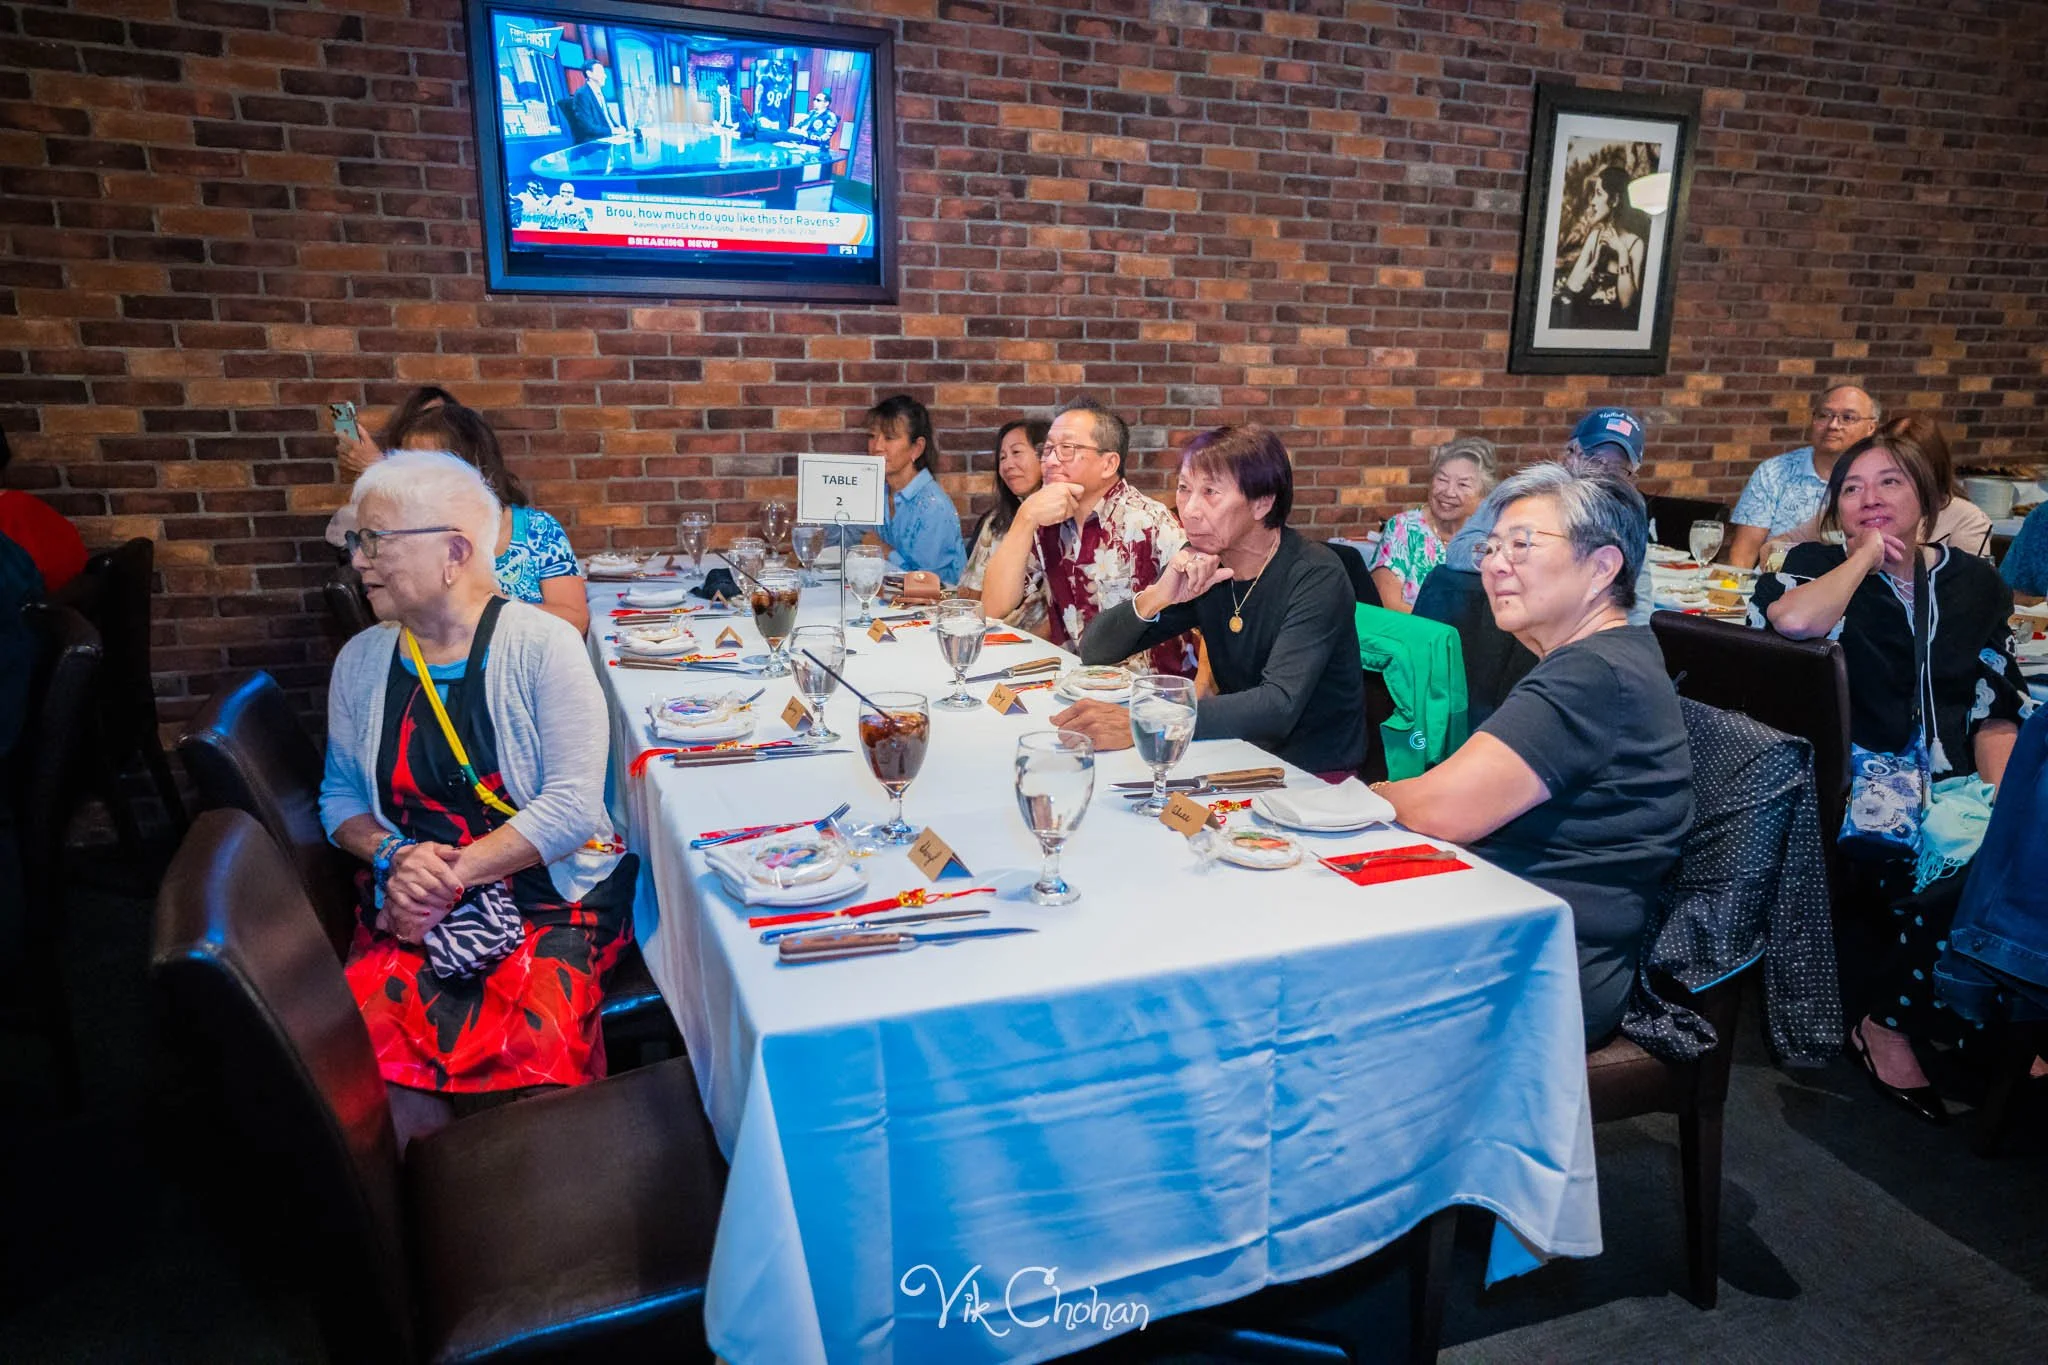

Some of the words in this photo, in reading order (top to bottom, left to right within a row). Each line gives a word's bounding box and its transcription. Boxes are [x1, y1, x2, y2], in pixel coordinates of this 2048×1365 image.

[525, 32, 552, 48] FIRST
[766, 91, 782, 108] 98
[638, 207, 662, 219] how
[664, 210, 696, 220] much
[698, 211, 712, 221] do
[714, 214, 735, 224] you
[736, 213, 755, 224] like
[758, 214, 777, 225] this
[779, 215, 793, 225] for
[796, 216, 840, 227] Ravens?
[627, 237, 685, 248] BREAKING
[687, 239, 719, 249] NEWS
[840, 245, 858, 255] FS1
[822, 475, 858, 486] TABLE
[835, 496, 843, 506] 2
